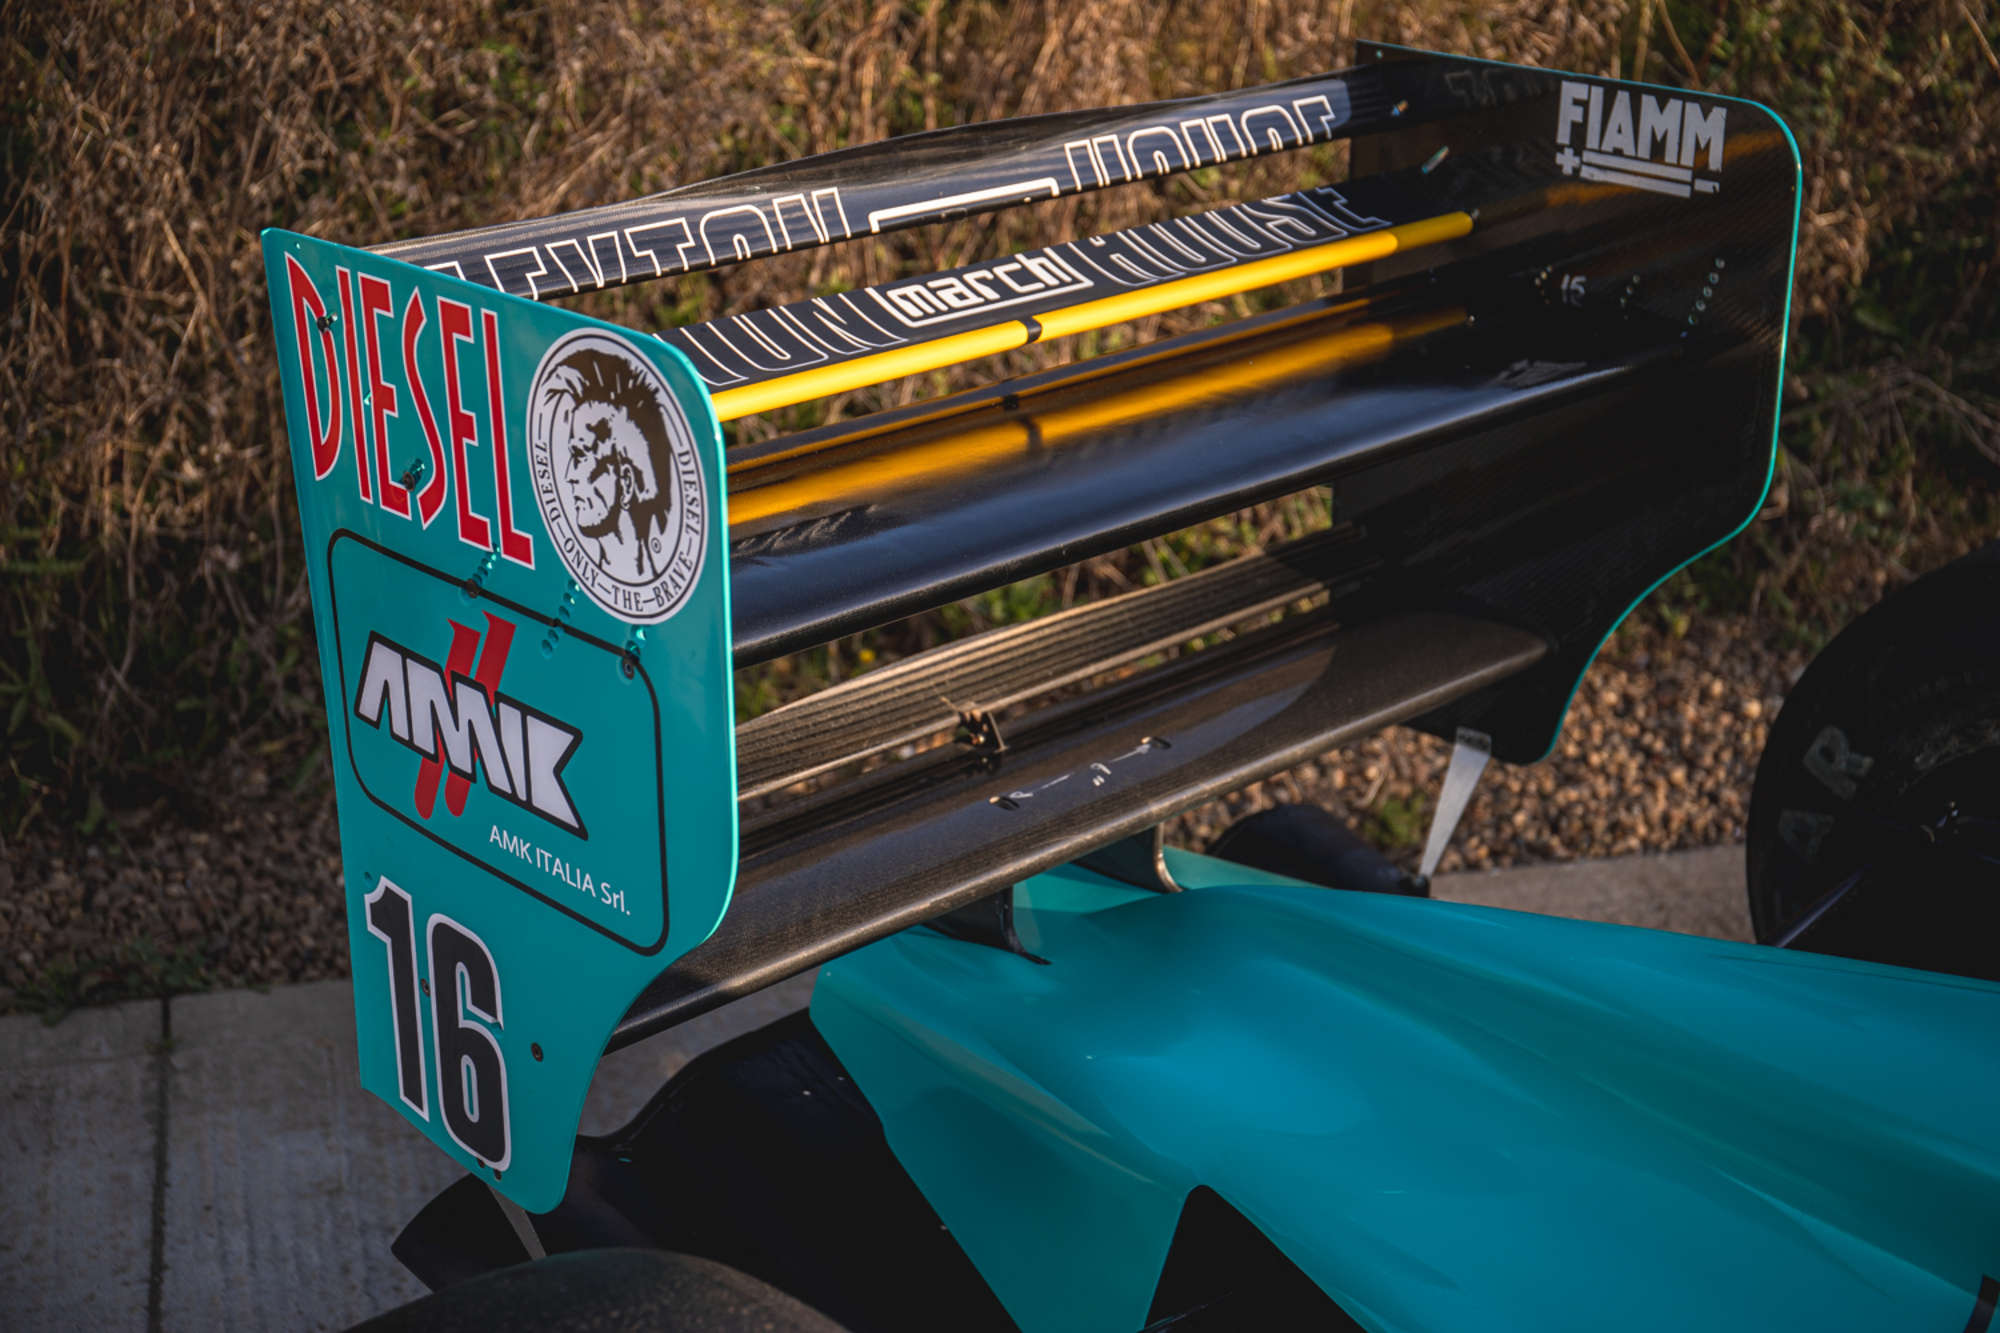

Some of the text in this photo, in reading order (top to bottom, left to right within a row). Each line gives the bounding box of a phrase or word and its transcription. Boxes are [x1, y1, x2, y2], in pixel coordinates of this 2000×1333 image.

[1556, 80, 1727, 173] FIAMM
[887, 252, 1073, 318] march
[284, 252, 535, 570] DIESEL
[534, 442, 561, 523] DIESEL
[677, 451, 700, 536] DIESEL
[563, 537, 693, 613] ONLY THE BRAVE
[354, 630, 588, 840] AMK
[489, 825, 631, 916] AMK ITALIA Srl.
[363, 875, 512, 1172] 16
